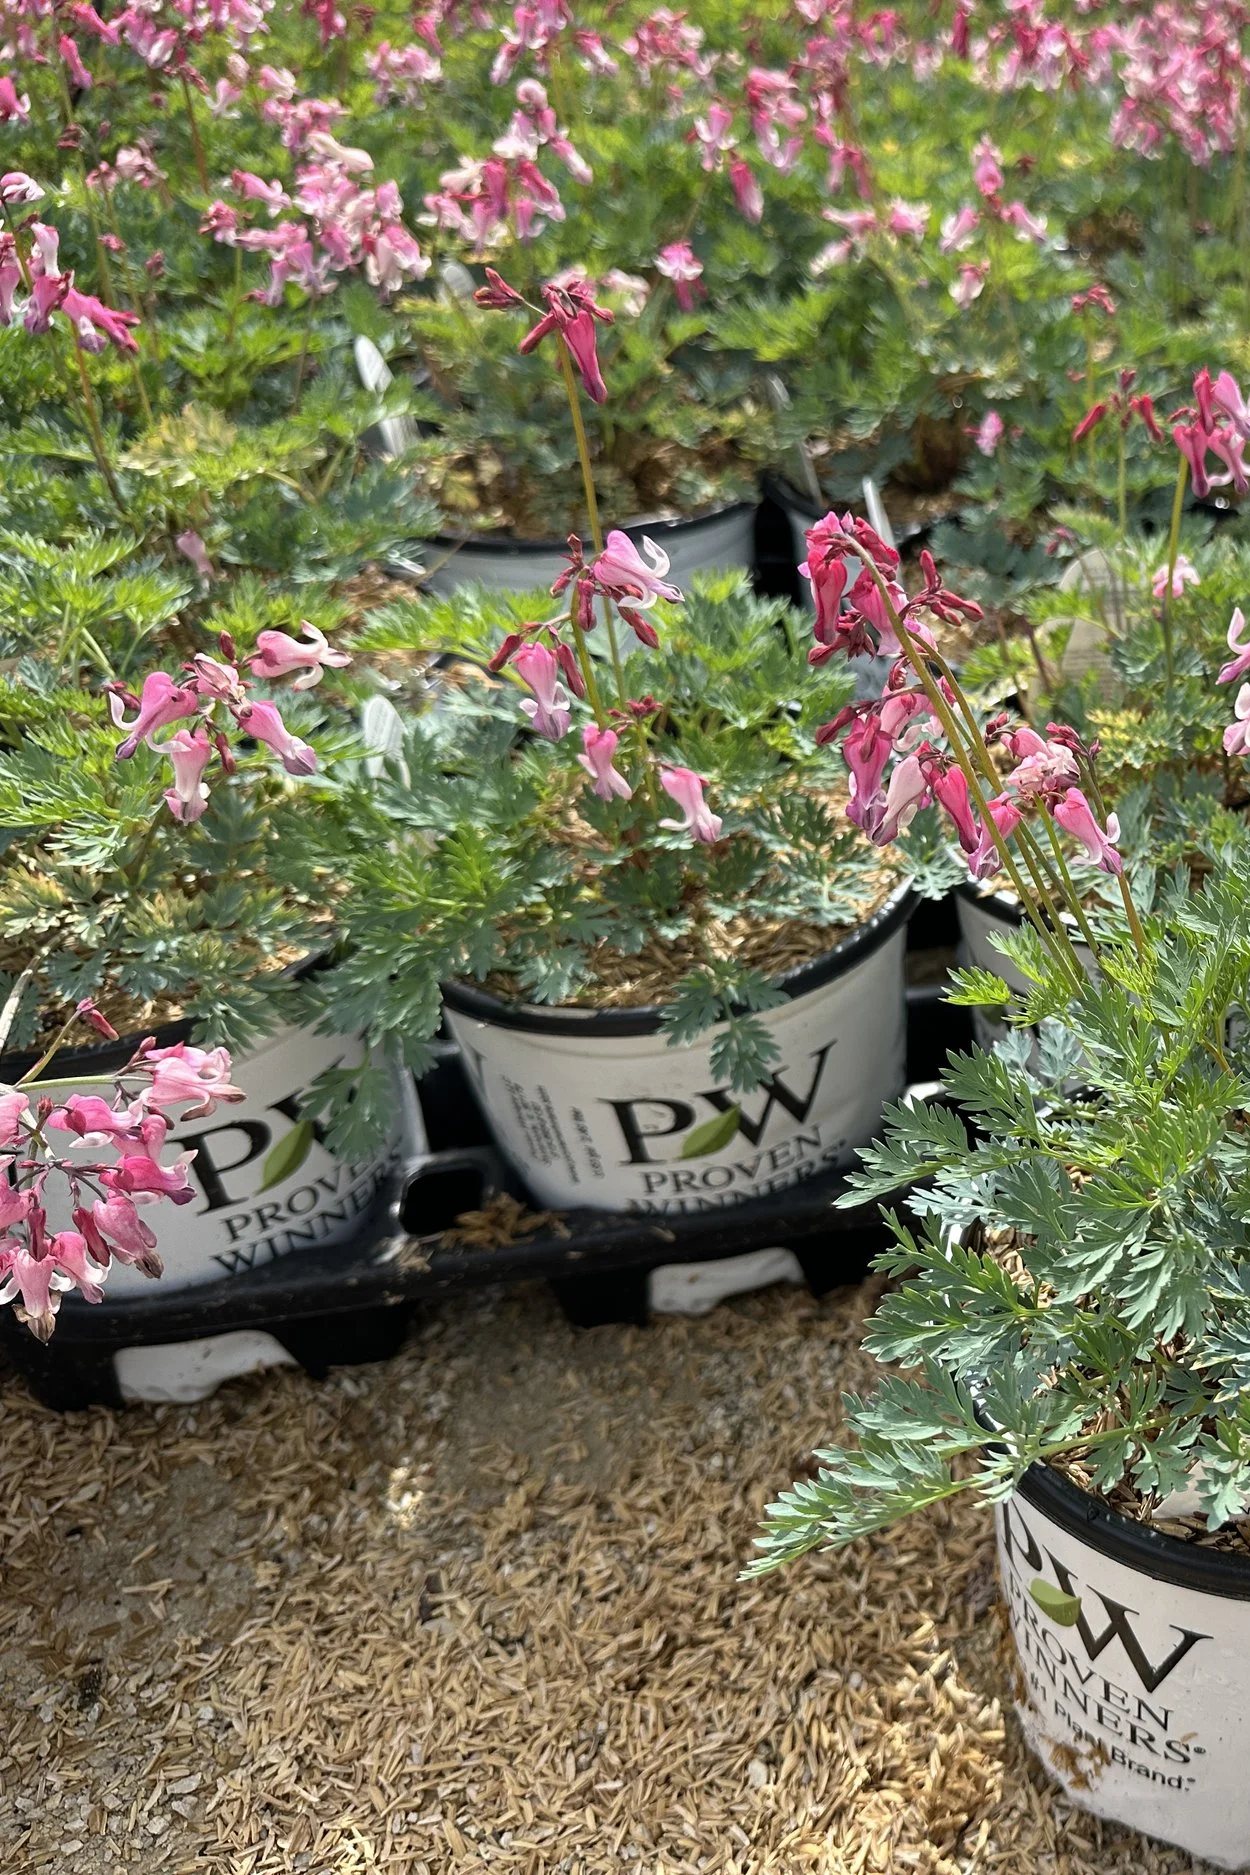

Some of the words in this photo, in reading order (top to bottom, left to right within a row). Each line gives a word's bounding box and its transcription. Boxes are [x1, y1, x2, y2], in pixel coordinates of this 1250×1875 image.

[588, 1038, 839, 1166] PW
[640, 1124, 822, 1195] PROVEN
[1005, 1567, 1175, 1732] PROVEN
